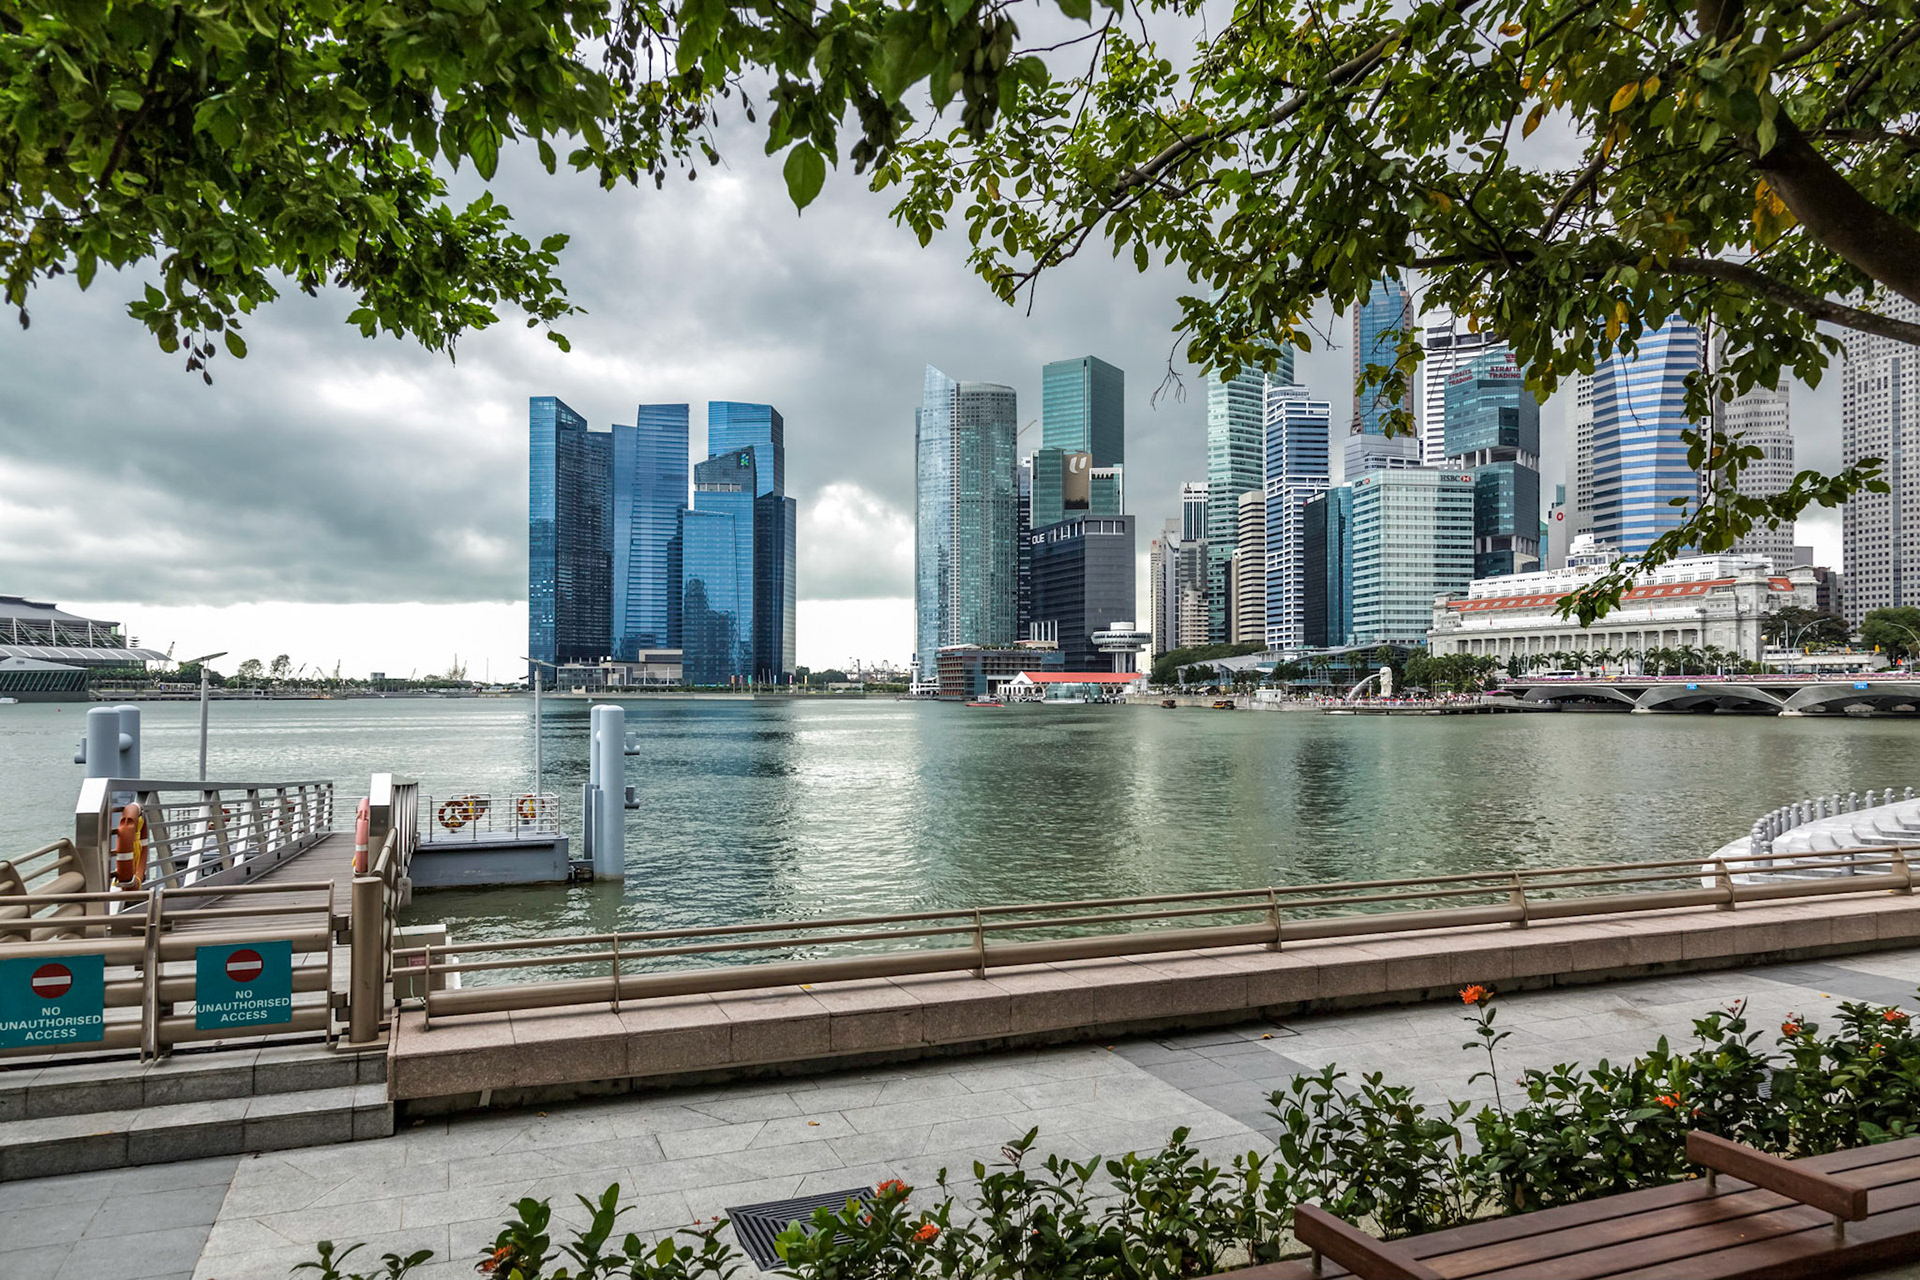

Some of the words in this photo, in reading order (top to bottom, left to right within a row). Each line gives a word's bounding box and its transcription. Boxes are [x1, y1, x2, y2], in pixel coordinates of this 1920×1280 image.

[1031, 533, 1045, 545] OUE
[235, 990, 253, 999] NO
[41, 1006, 61, 1016] NO
[197, 997, 290, 1014] UNAUTHORISED
[0, 1015, 102, 1031] UNAUTHORISED
[220, 1010, 268, 1023] ACCESS
[24, 1028, 77, 1041] ACCESS
